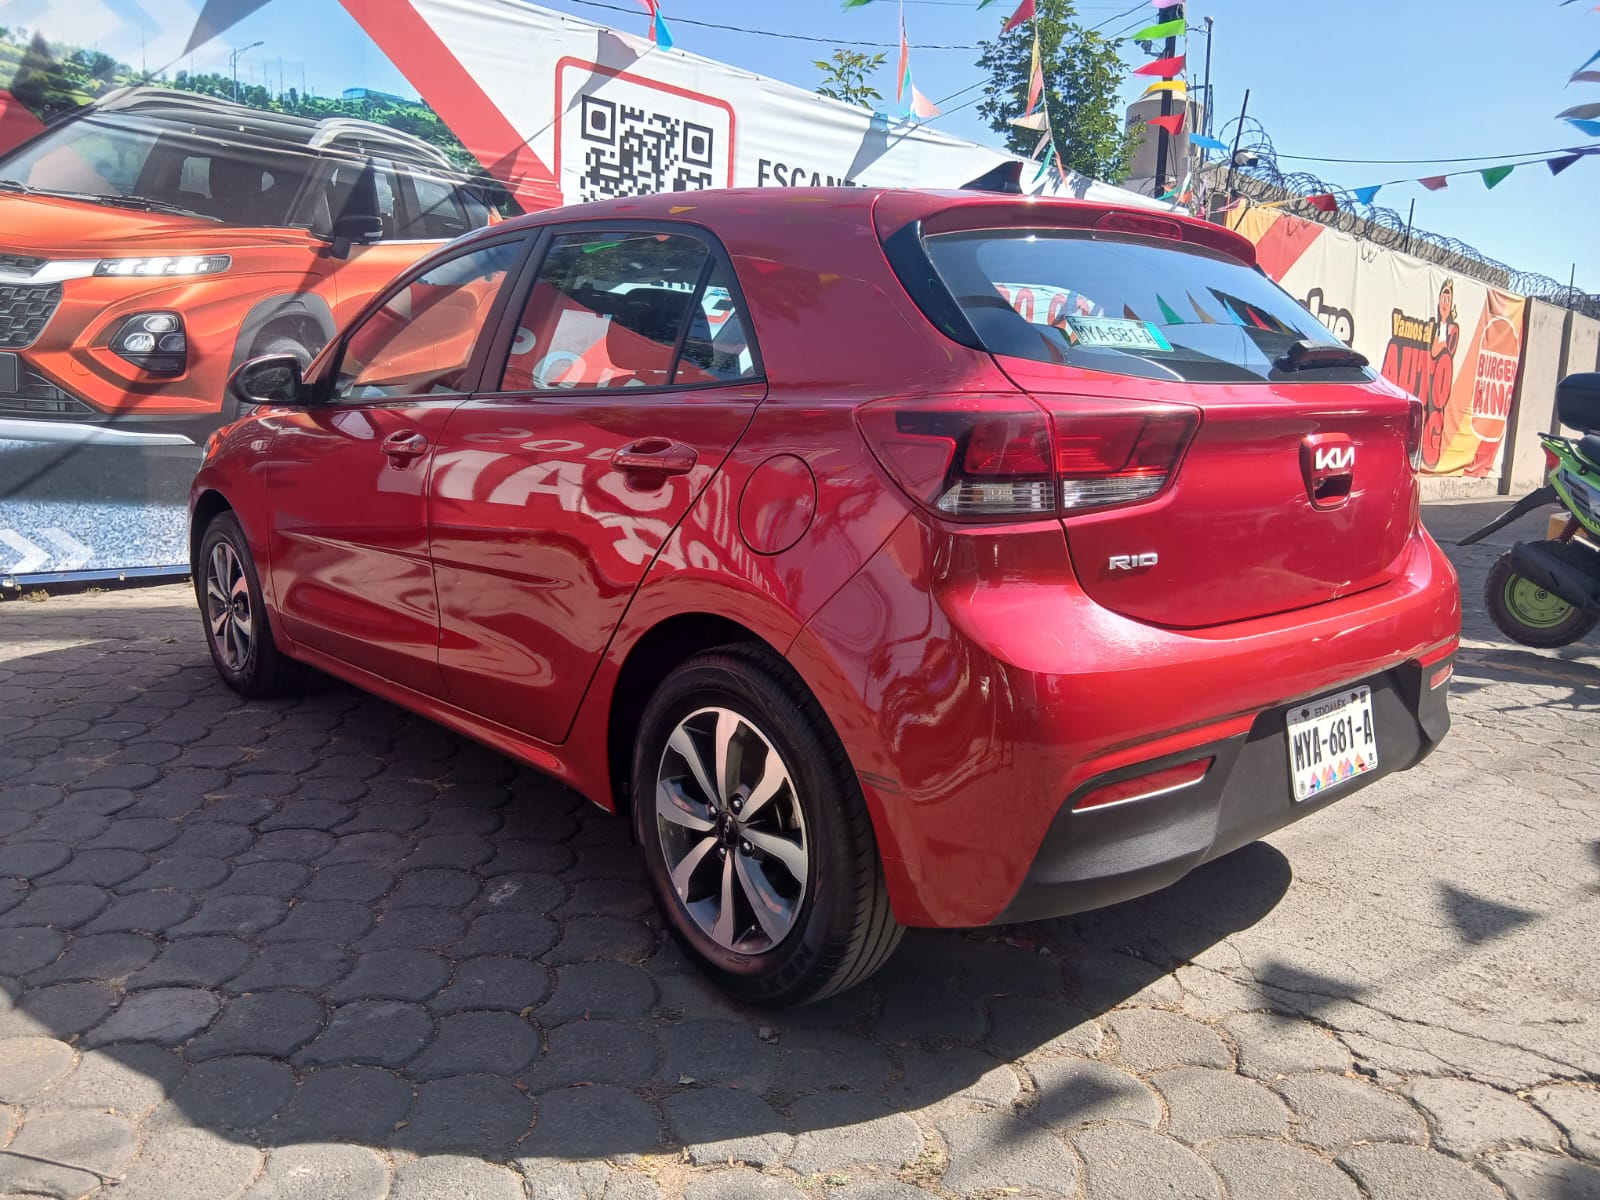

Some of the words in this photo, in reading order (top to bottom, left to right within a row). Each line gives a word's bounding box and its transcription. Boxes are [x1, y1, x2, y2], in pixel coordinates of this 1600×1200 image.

[1393, 312, 1423, 341] Vamos
[1422, 321, 1434, 345] al
[1381, 342, 1453, 409] AUTO
[1477, 353, 1517, 383] BURGER
[1472, 379, 1514, 417] KING
[1315, 446, 1355, 470] KIA
[1109, 552, 1159, 570] RIO
[1293, 709, 1374, 773] MYA-681-A
